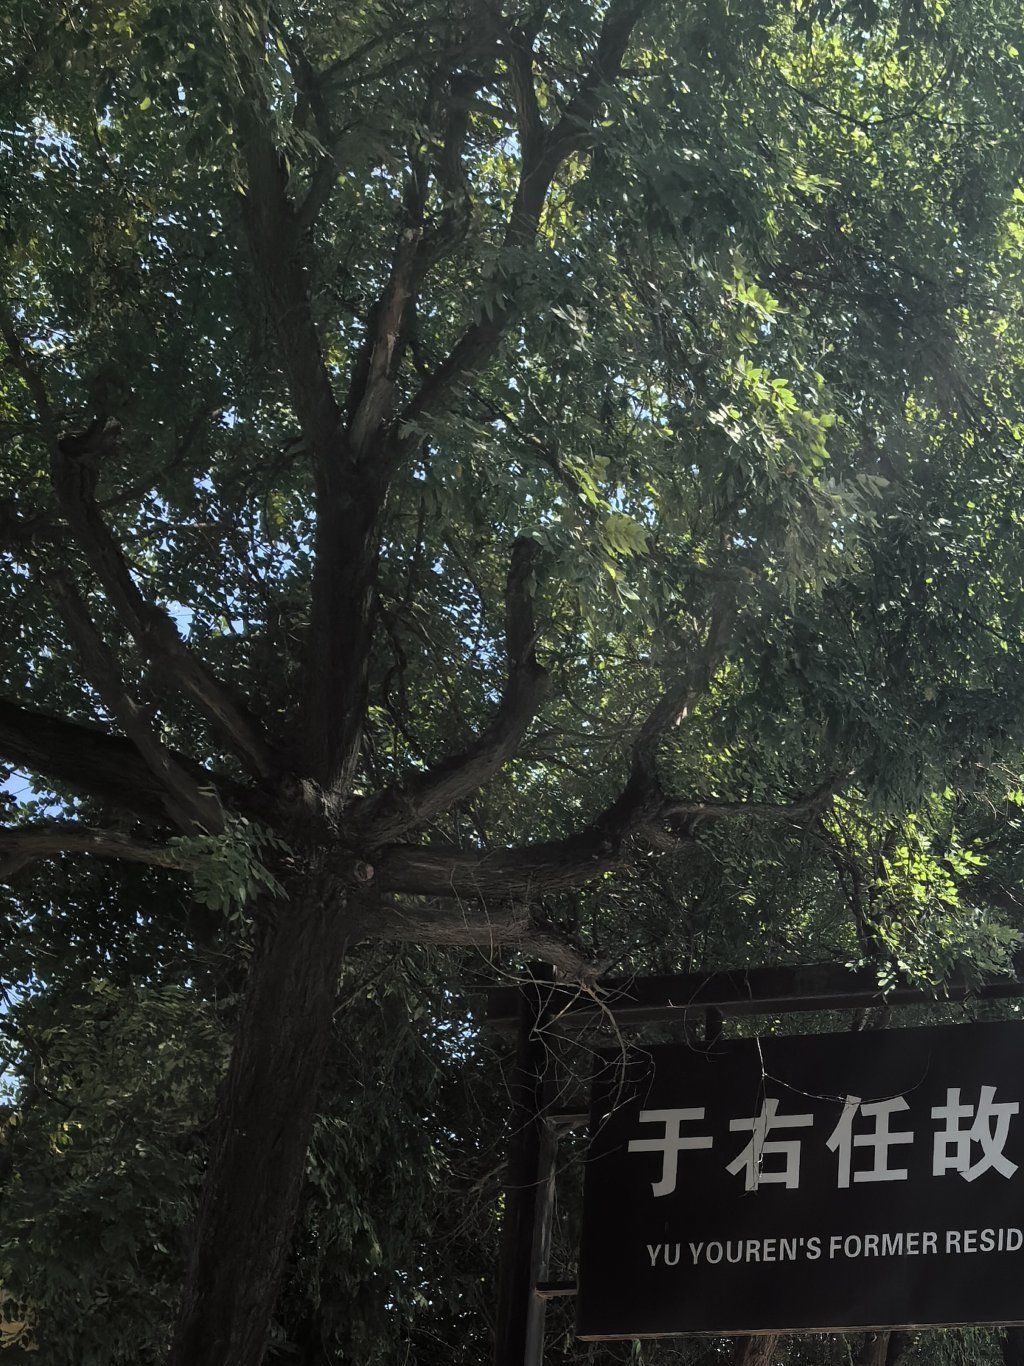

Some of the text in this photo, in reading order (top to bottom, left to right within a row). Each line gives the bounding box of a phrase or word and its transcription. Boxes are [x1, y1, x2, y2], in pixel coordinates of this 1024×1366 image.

[646, 1243, 681, 1266] YU
[689, 1236, 822, 1265] YOUREN'S
[829, 1231, 938, 1259] FORMER
